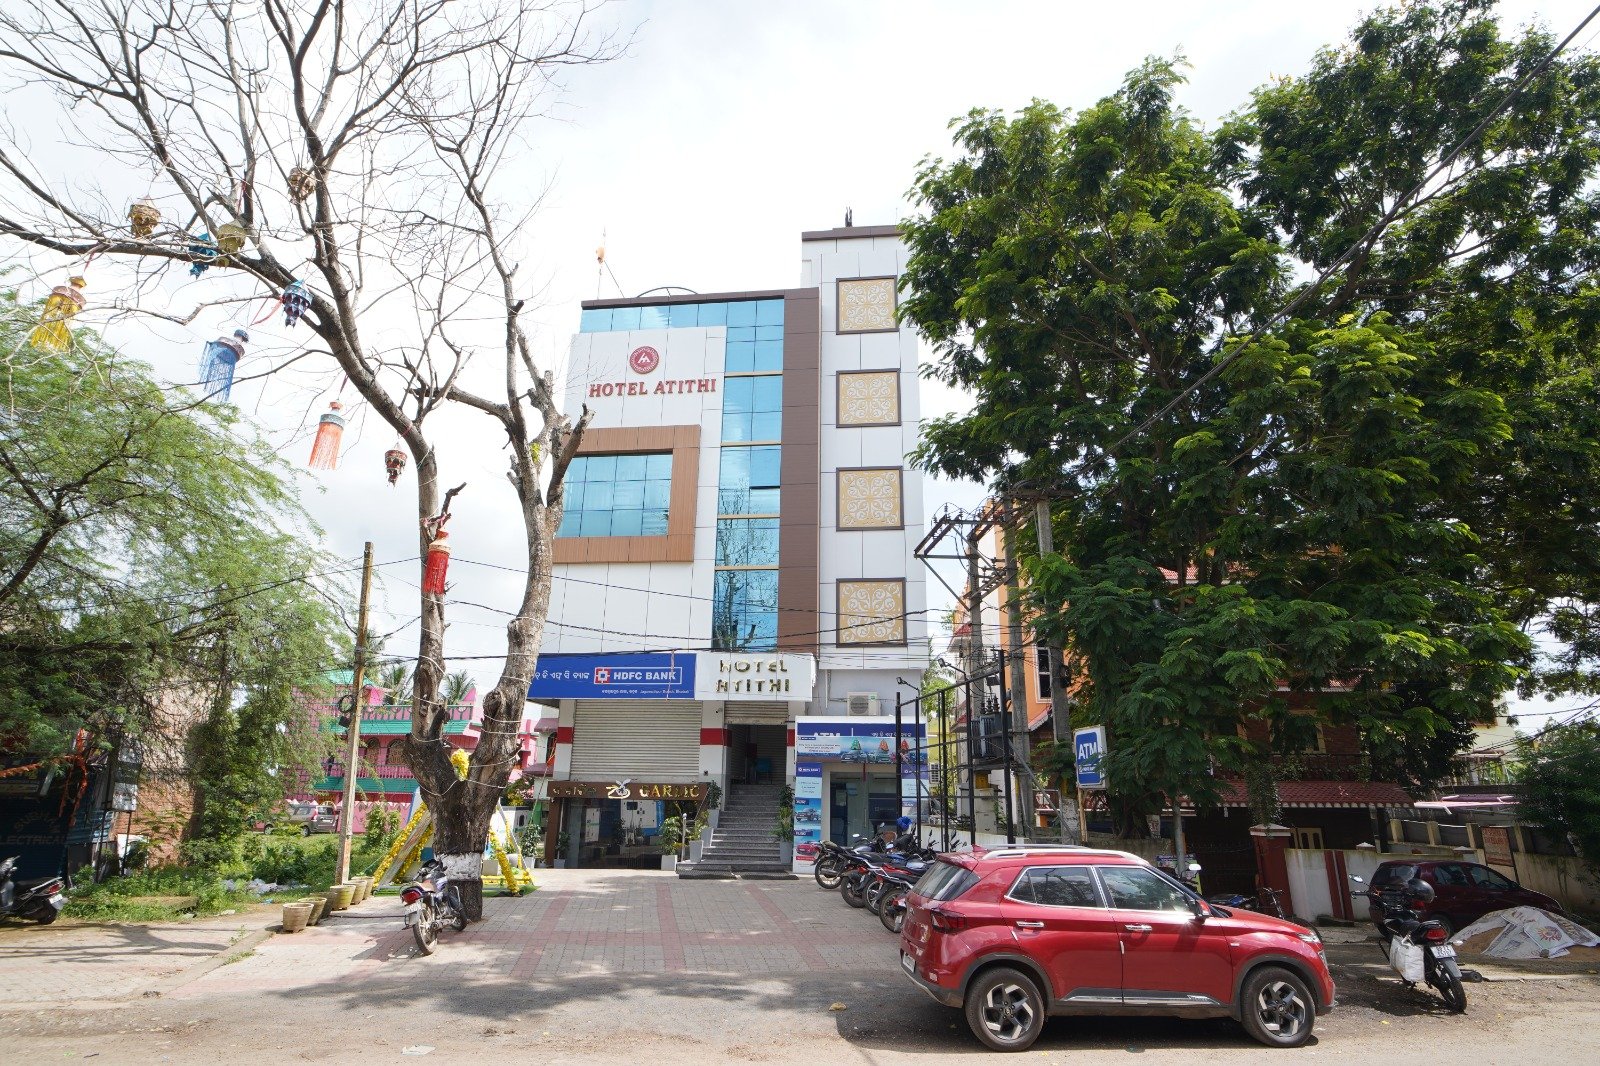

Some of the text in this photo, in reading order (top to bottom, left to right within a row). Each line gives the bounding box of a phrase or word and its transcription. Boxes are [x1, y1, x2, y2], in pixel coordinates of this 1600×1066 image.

[589, 379, 717, 397] HOTEL ATITHI
[720, 659, 788, 673] HOTEL
[613, 671, 677, 681] HDFC BANK
[716, 679, 790, 693] ATITHI
[1078, 741, 1098, 760] ATM
[639, 784, 700, 798] GARLIC
